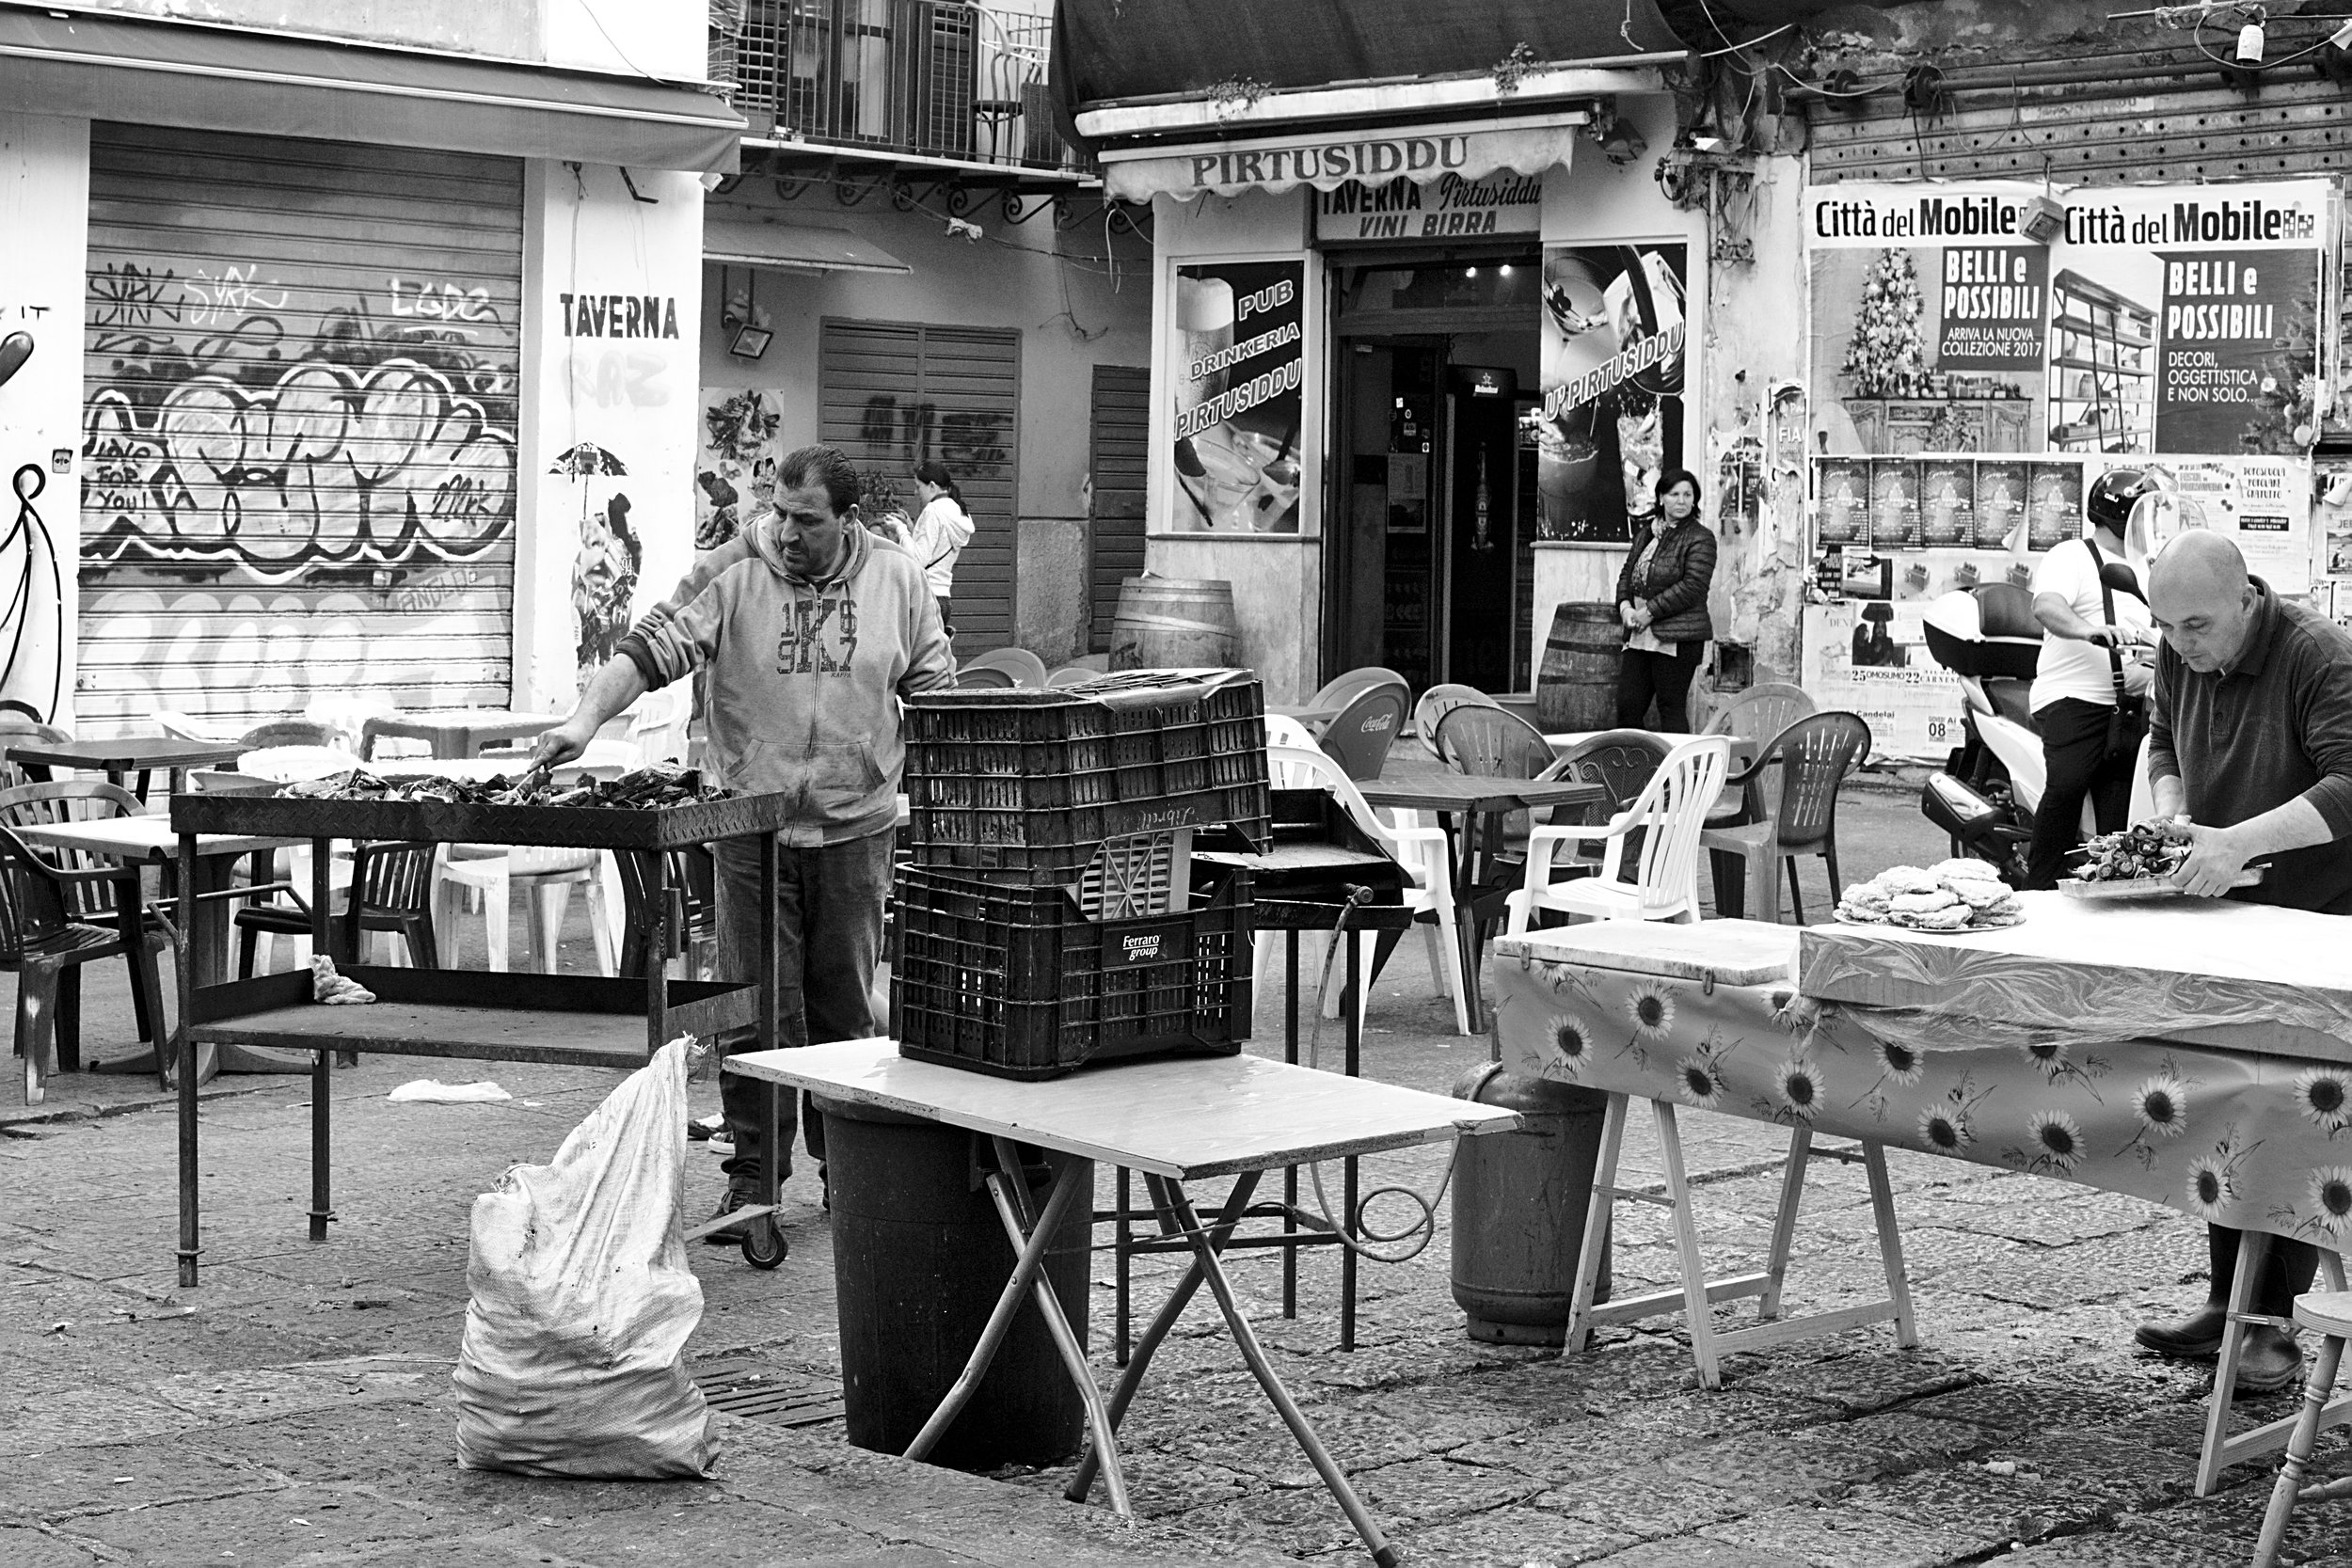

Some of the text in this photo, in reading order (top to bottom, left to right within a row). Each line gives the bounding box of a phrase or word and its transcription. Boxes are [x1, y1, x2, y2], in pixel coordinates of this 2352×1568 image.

[1190, 135, 1470, 187] PIRTUSIDDU
[1439, 171, 1542, 211] Pirtusiddu
[1359, 210, 1497, 237] VINI BIRRA
[1816, 197, 2016, 238] Città del Mobile
[2064, 199, 2283, 245] Città del Mobile
[1946, 249, 2027, 283] BELLI e
[2169, 261, 2258, 295] BELLI e
[560, 293, 679, 340] TAVERNA
[1238, 279, 1294, 321] PUB
[1944, 285, 2040, 320] POSSIBILI
[1947, 327, 2034, 341] ARRIVA LA NUOVA
[2168, 304, 2274, 340] POSSIBILI
[1190, 322, 1300, 381] DRINKERIA
[1567, 321, 1685, 410] PIRTUSIDDU
[1941, 341, 2042, 356] COLLEZIONE 2017
[2169, 351, 2219, 368] DECORI,
[2168, 369, 2258, 386] OGGETTISTICA
[2168, 388, 2175, 402] E
[2178, 387, 2209, 402] NON
[1175, 357, 1302, 442] PIRTUSIDDU
[1779, 426, 1804, 443] FIA
[1851, 670, 1906, 682] 25 OMOSUMO
[1905, 671, 1920, 684] 22
[1929, 722, 1947, 736] 08
[1122, 935, 1160, 948] Ferraro
[1129, 946, 1158, 961] group
